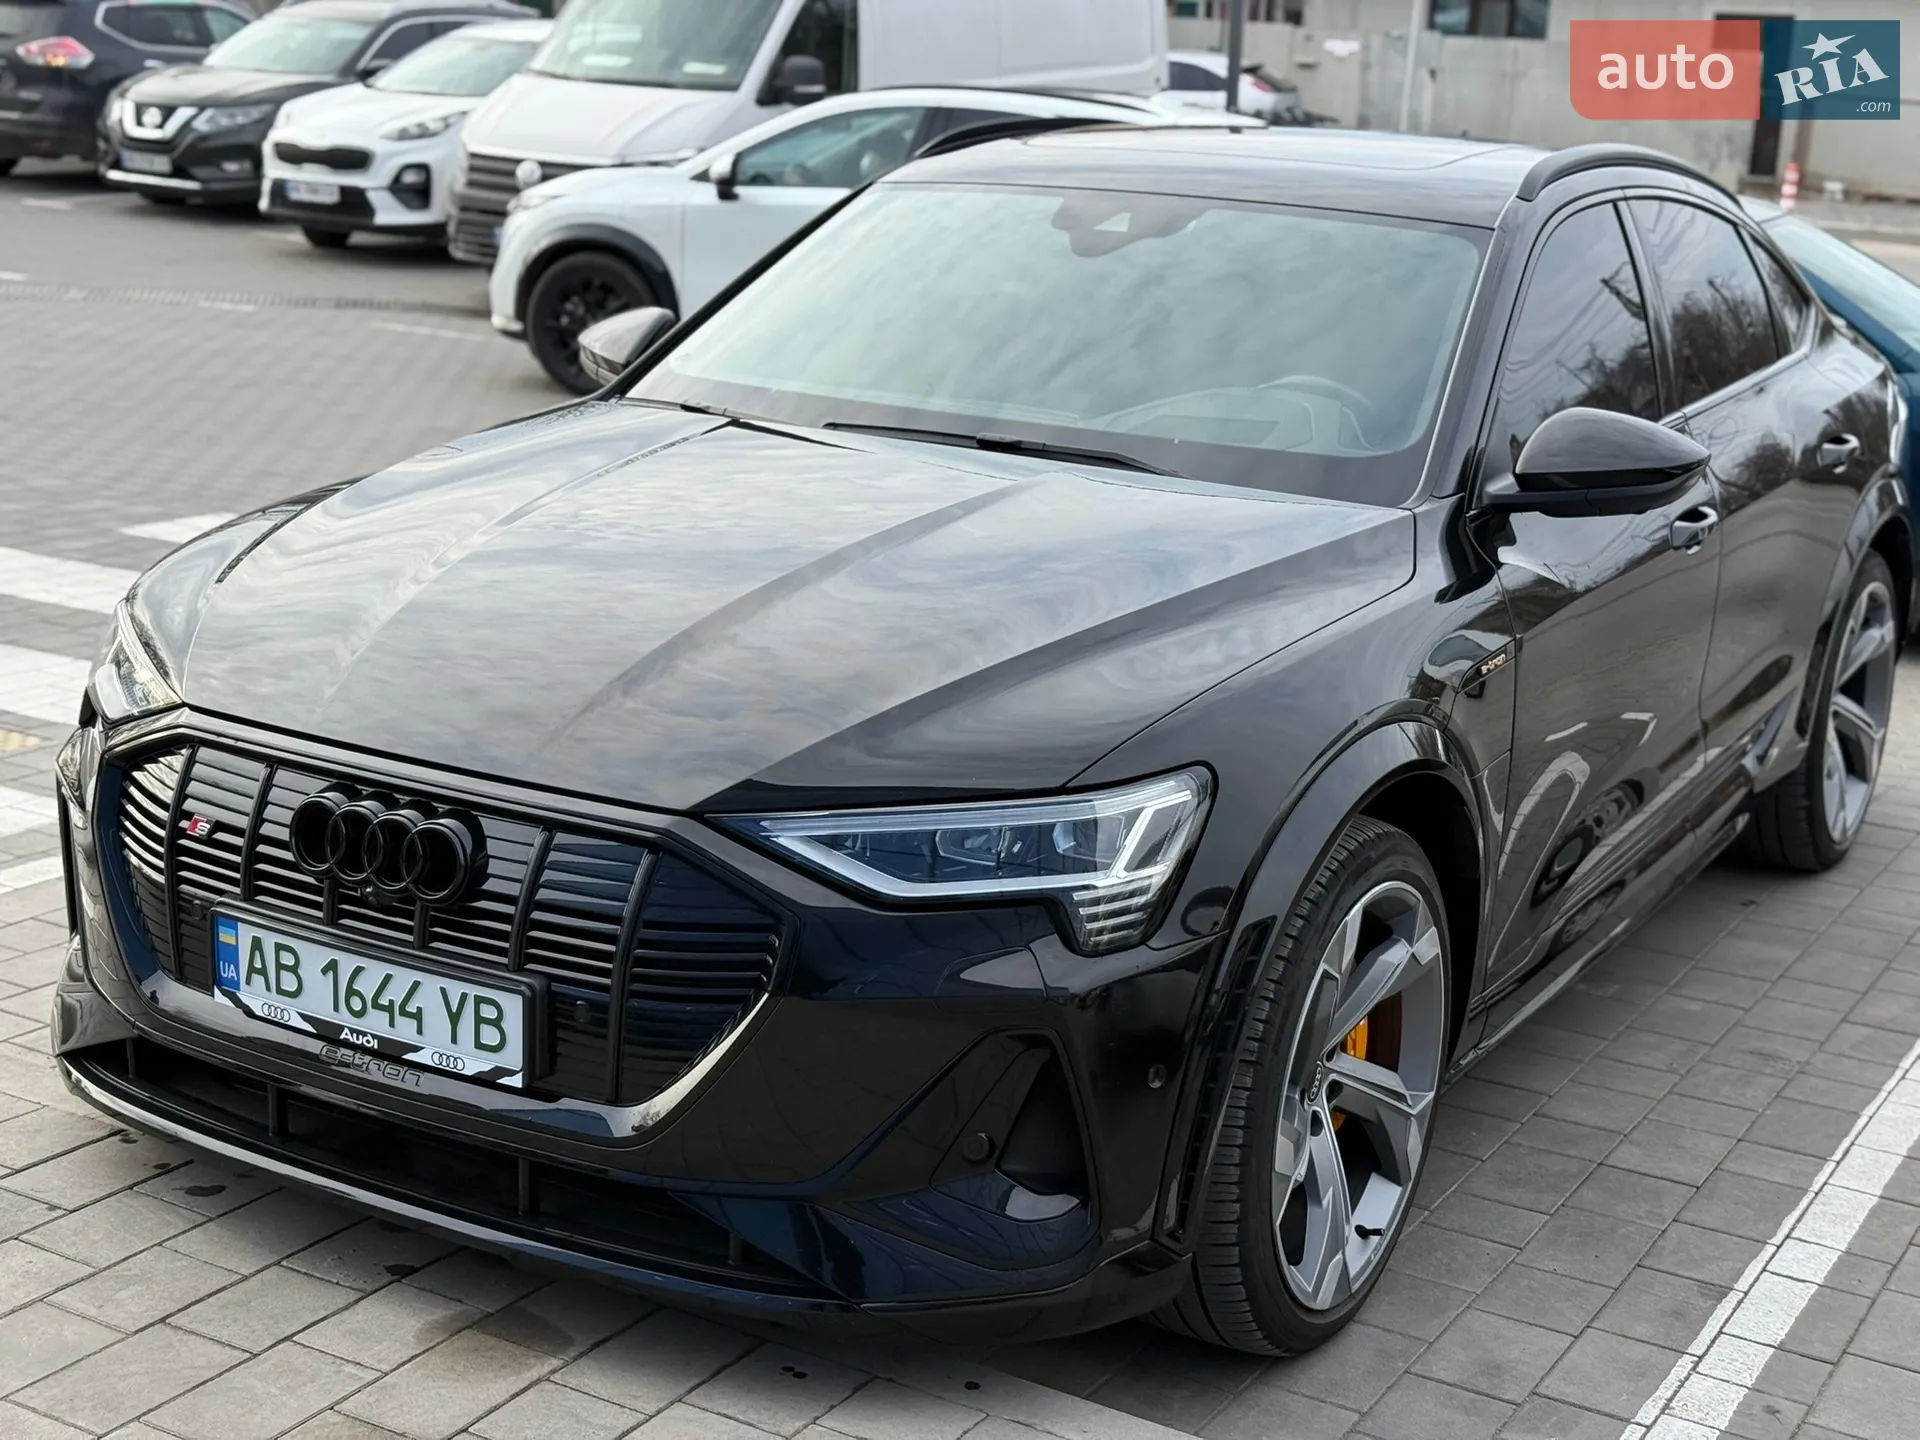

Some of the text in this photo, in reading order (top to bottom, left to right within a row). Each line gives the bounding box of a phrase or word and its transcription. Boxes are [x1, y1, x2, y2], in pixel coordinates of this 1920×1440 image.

[219, 960, 238, 982] UA
[245, 934, 508, 1054] AB 1644 YB
[339, 1026, 379, 1050] Audi
[317, 1044, 425, 1088] e-tron
